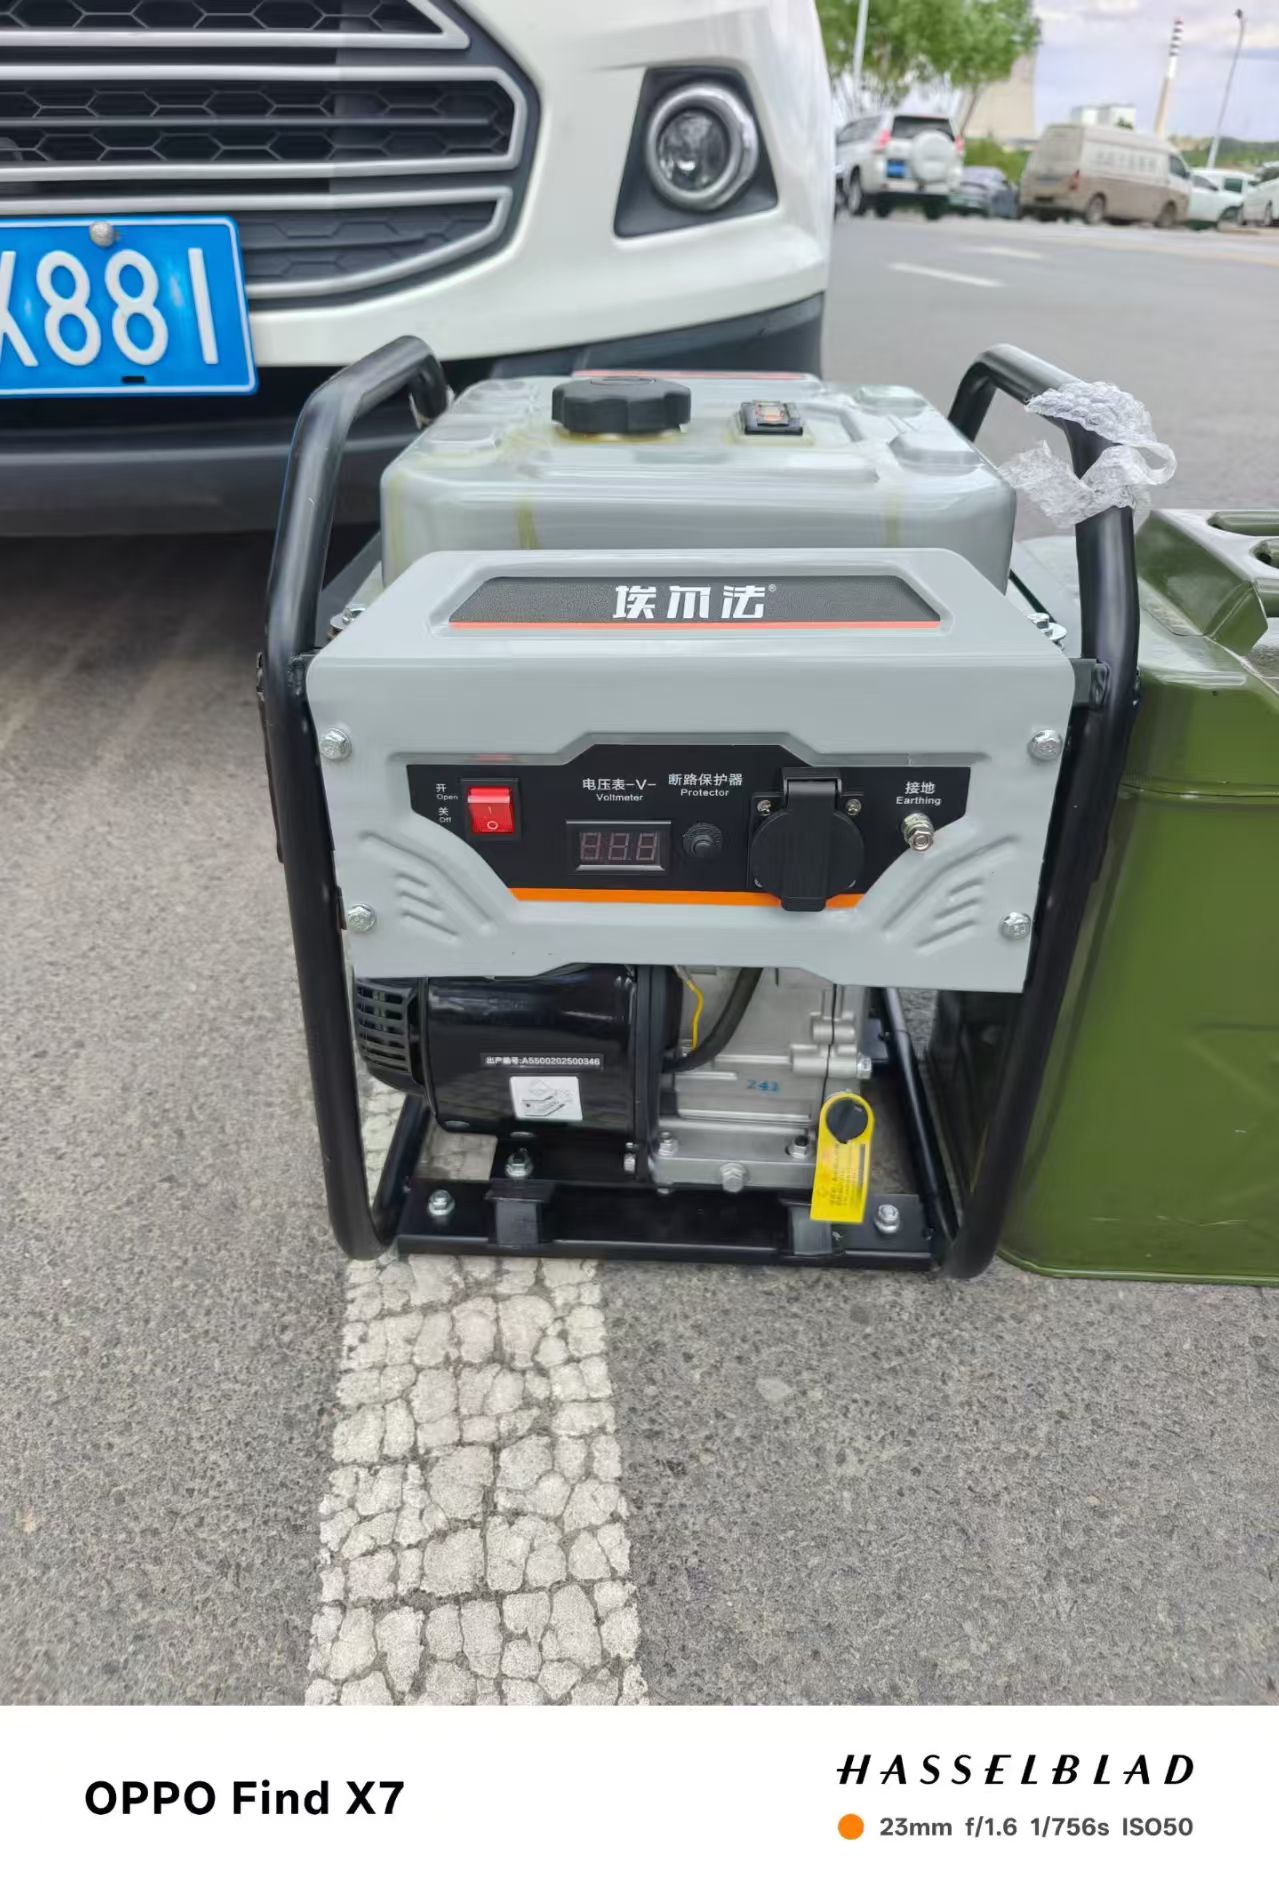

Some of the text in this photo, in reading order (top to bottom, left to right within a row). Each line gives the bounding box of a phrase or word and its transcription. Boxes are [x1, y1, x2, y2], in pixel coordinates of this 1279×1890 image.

[668, 773, 743, 787] 断路保护器
[436, 783, 447, 793] 开
[680, 788, 729, 797] Protector
[904, 781, 935, 795] 接地
[436, 793, 459, 801] Open
[596, 793, 644, 802] Voltmeter
[896, 796, 942, 806] Earthing
[438, 806, 449, 816] 关
